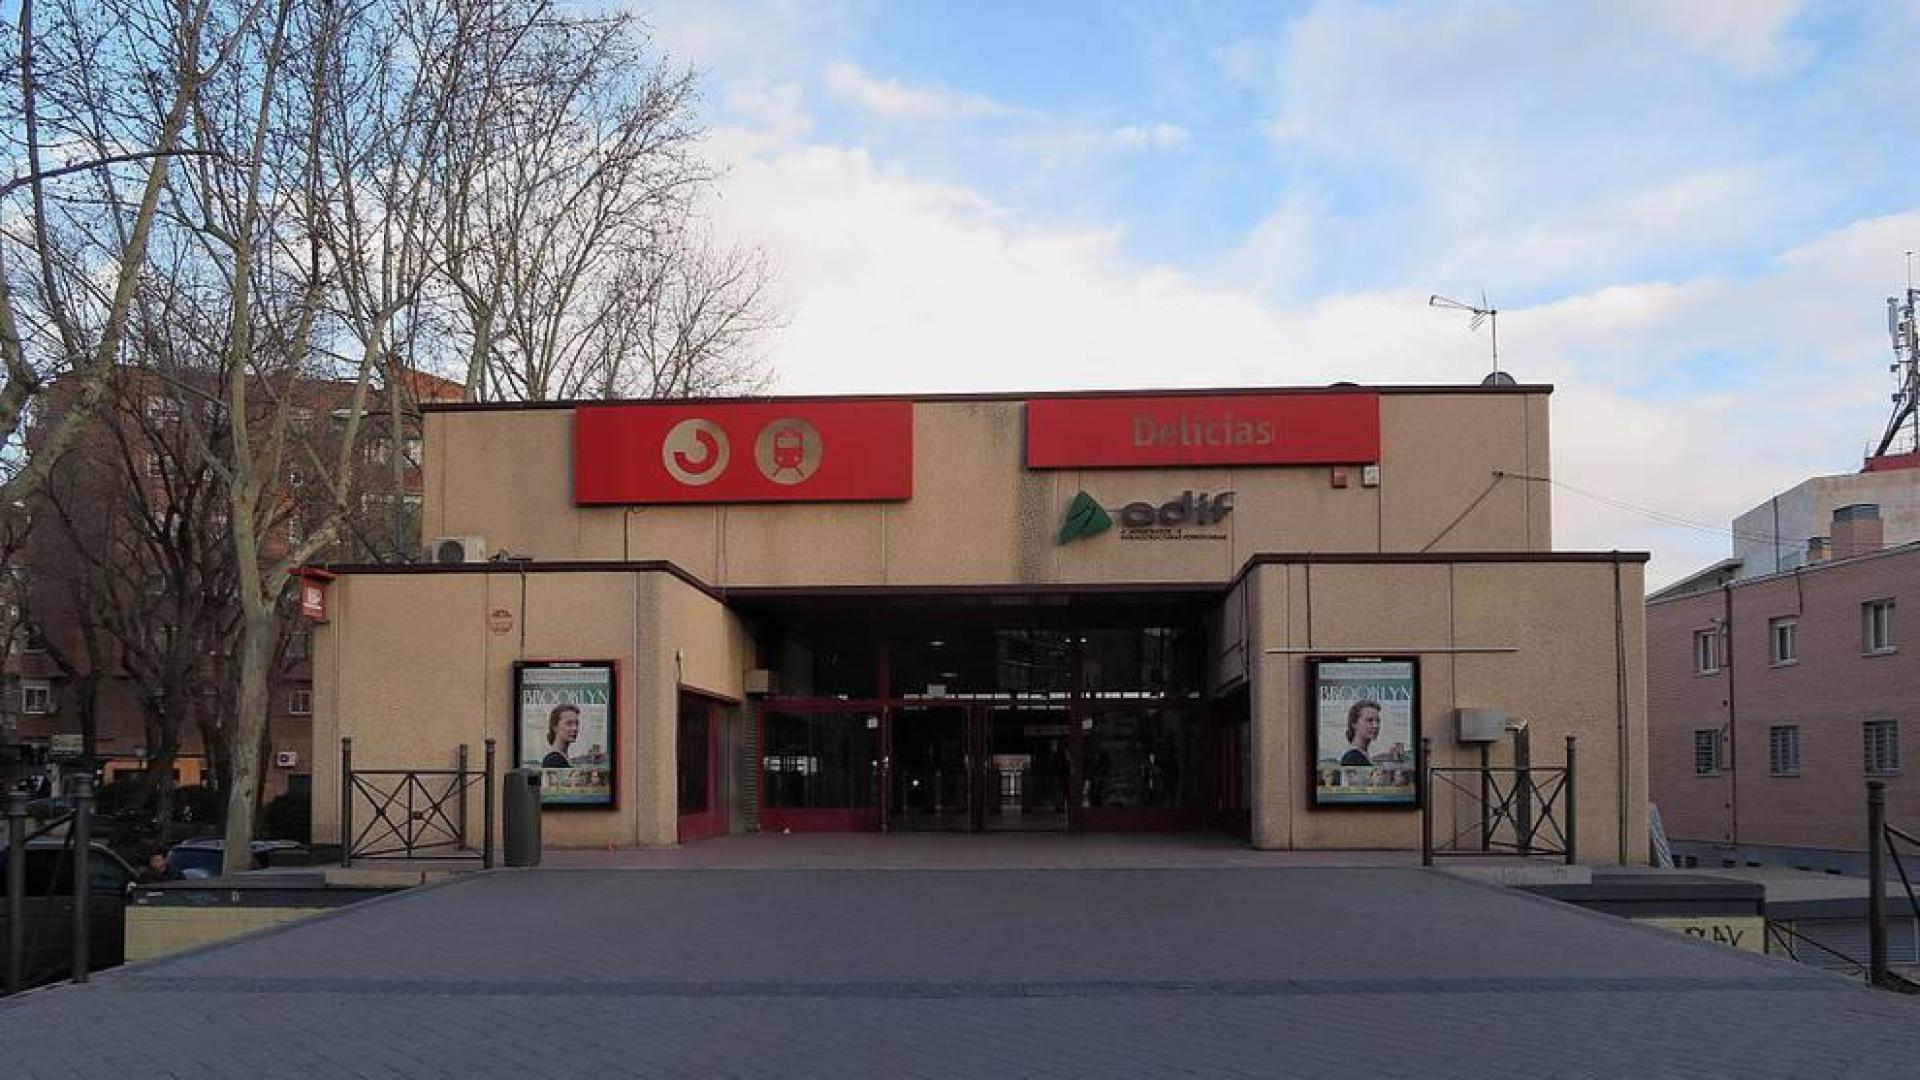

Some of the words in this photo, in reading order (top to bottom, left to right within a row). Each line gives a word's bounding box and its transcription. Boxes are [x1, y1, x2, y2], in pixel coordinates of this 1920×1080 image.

[1132, 412, 1273, 447] Delicias
[1120, 489, 1237, 528] adif
[522, 689, 607, 705] BROOKLYN
[1320, 685, 1411, 701] BROOKLYN
